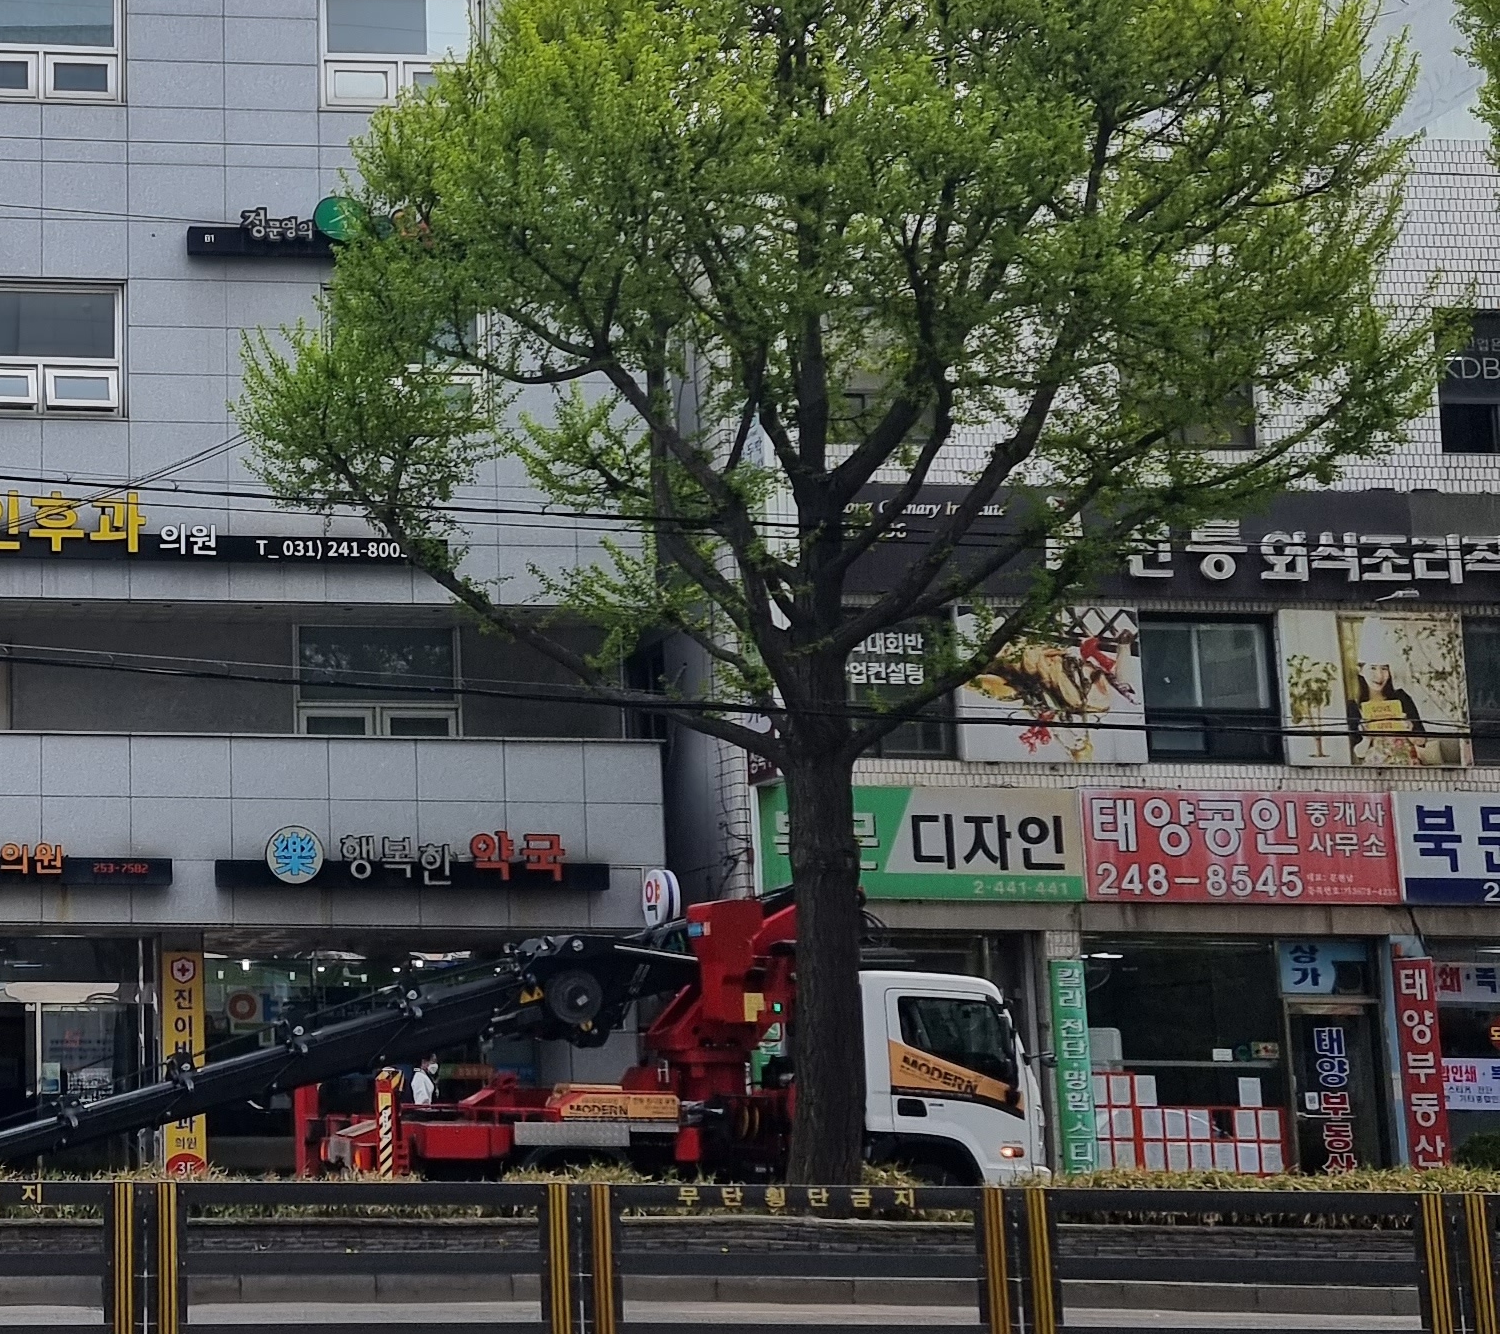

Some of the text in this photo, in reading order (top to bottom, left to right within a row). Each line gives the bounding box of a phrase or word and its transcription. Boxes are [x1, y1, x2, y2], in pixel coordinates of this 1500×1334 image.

[159, 523, 218, 556] 의원
[282, 539, 323, 560] 031)
[327, 541, 408, 559] 241-800
[845, 661, 925, 685] 업컨설팅
[1090, 797, 1299, 857] 태양공인
[1304, 800, 1385, 828] 중개사
[0, 842, 63, 875] 의원
[273, 831, 316, 876] 樂
[340, 830, 566, 886] 행복한 약국
[910, 813, 1066, 871] 디자인
[1308, 832, 1388, 858] 사무소
[645, 878, 661, 921] 약
[1289, 943, 1321, 988] 상가
[902, 1054, 979, 1096] MODERN
[1400, 968, 1446, 1168] 태양부동산
